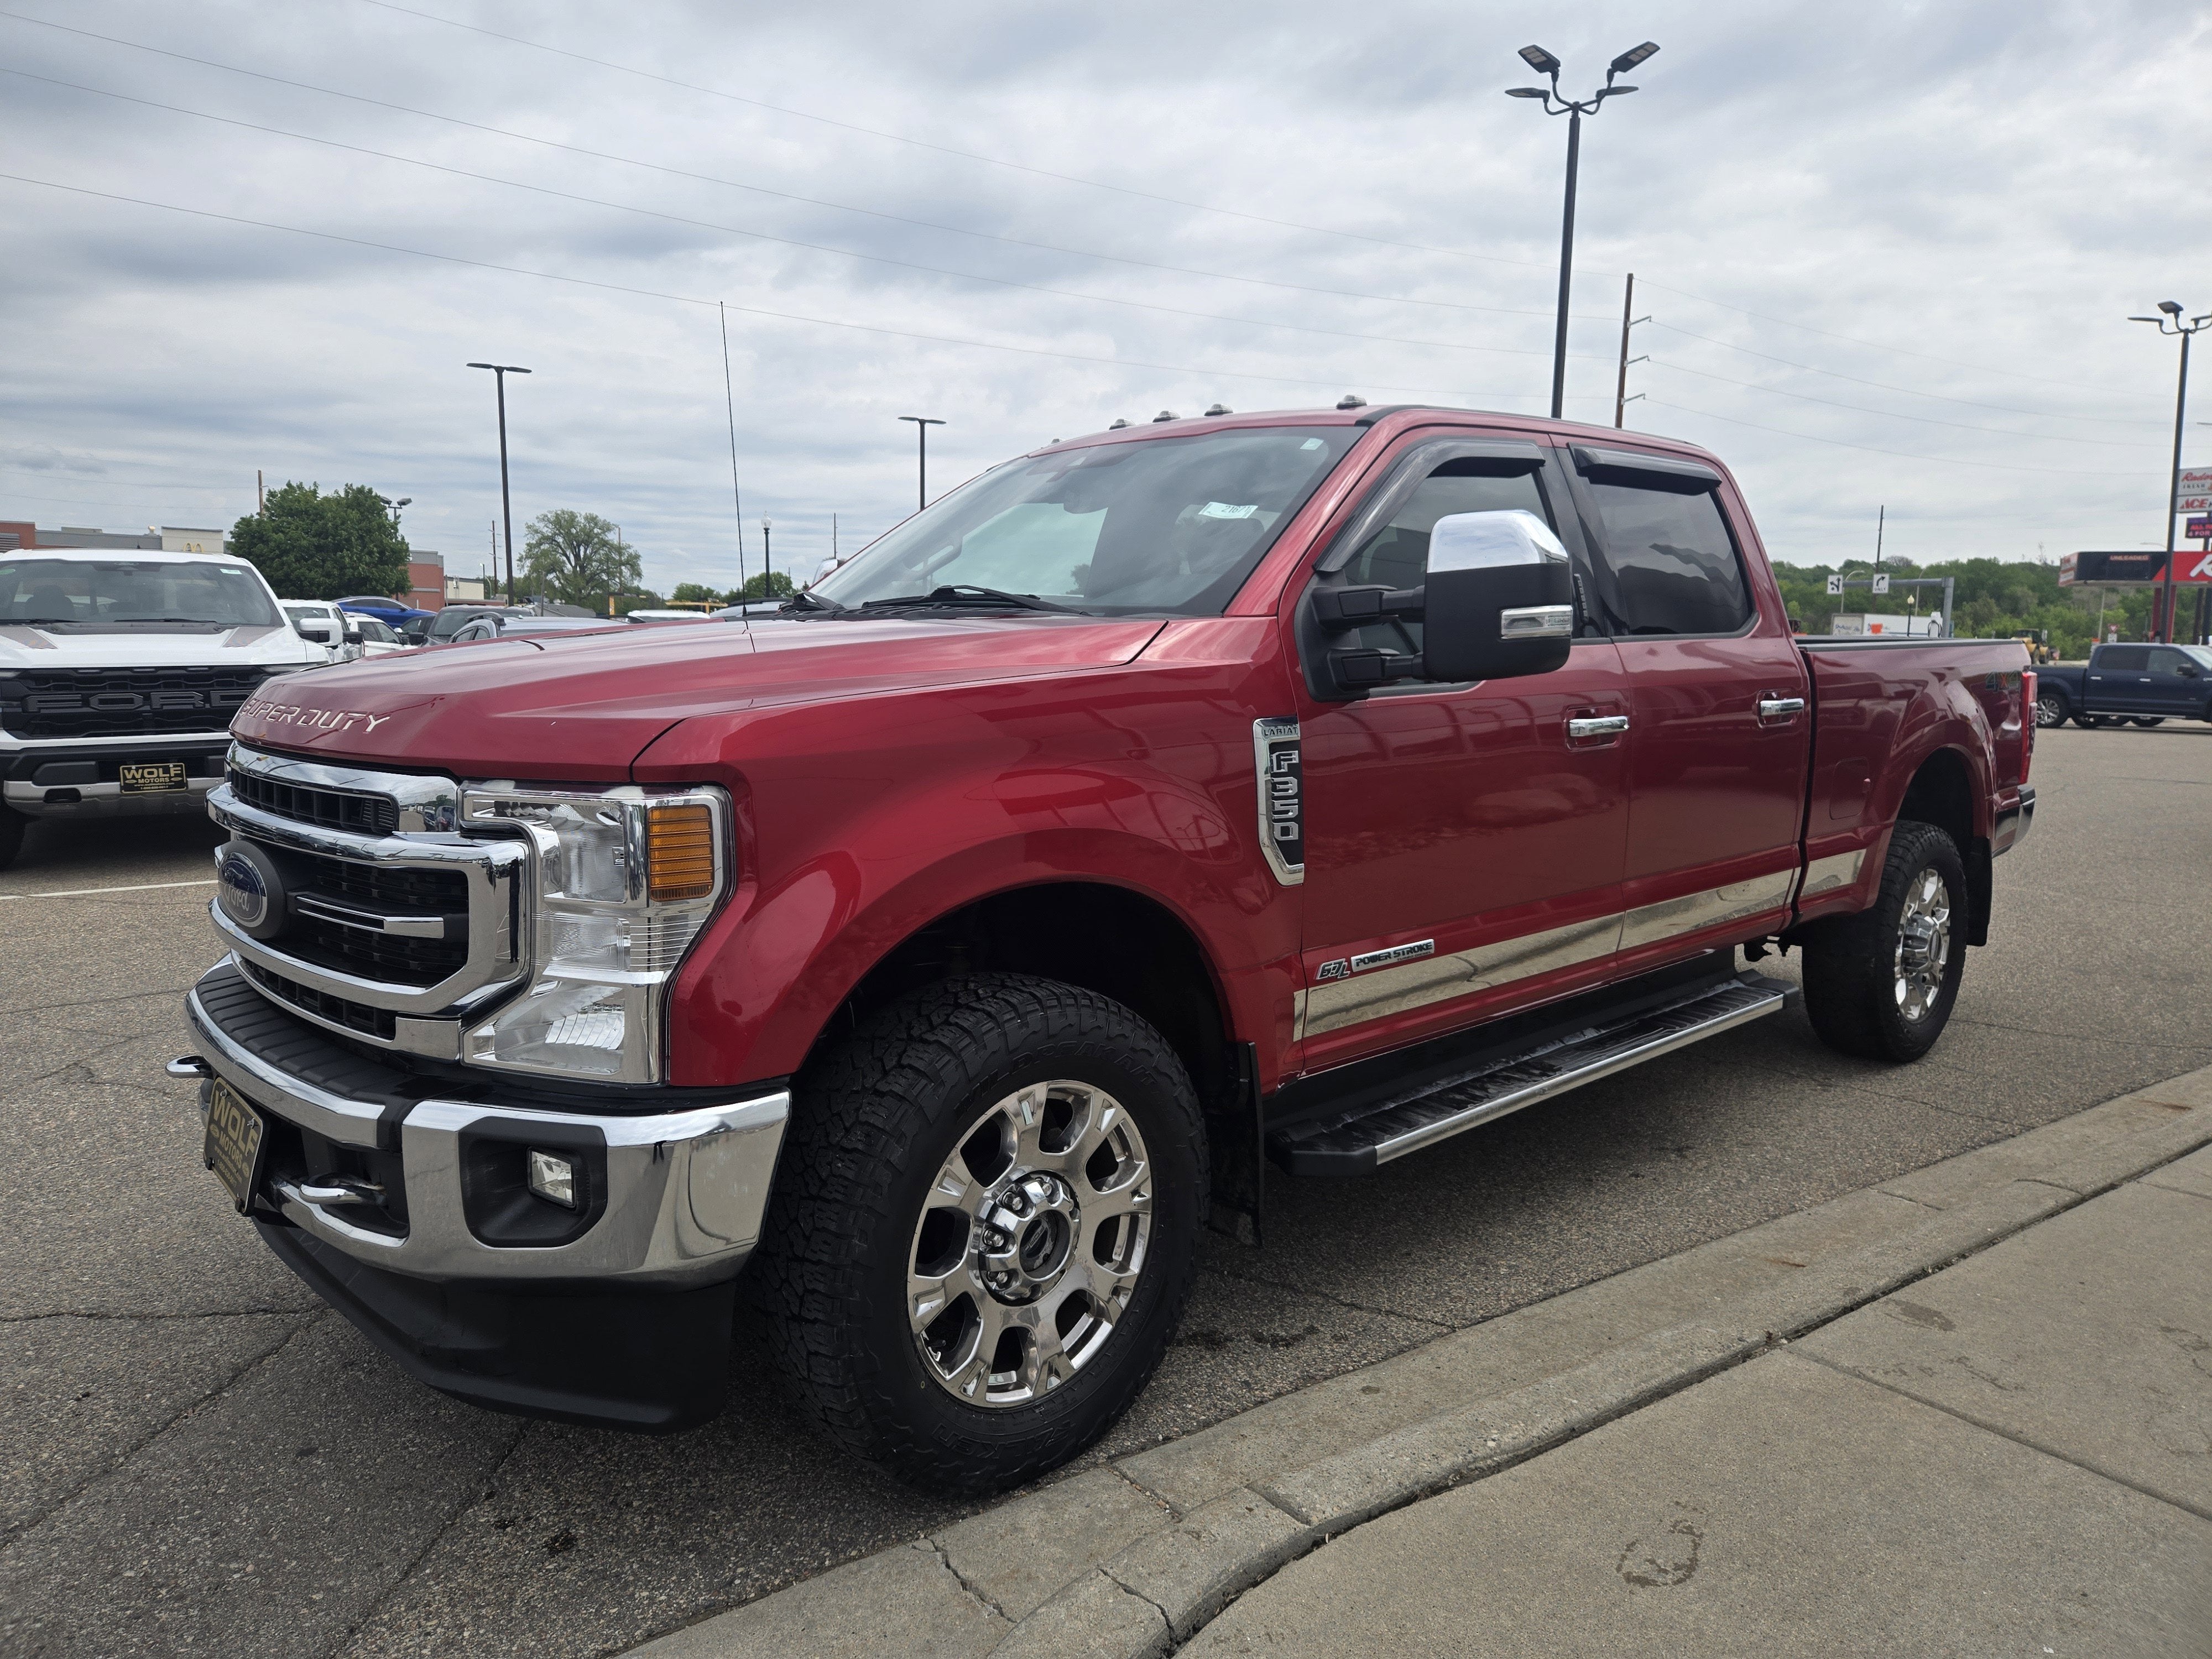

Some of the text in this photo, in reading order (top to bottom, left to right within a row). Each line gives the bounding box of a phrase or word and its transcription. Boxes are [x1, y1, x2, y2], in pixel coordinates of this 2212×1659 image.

[238, 698, 391, 734] SUPER DUTY
[1263, 727, 1298, 737] LARIAT
[124, 767, 181, 779] WOLF
[1355, 951, 1392, 968] POWER
[1392, 942, 1433, 958] STROKE
[213, 1090, 258, 1157] WOLF
[219, 1131, 243, 1169] MOTORS
